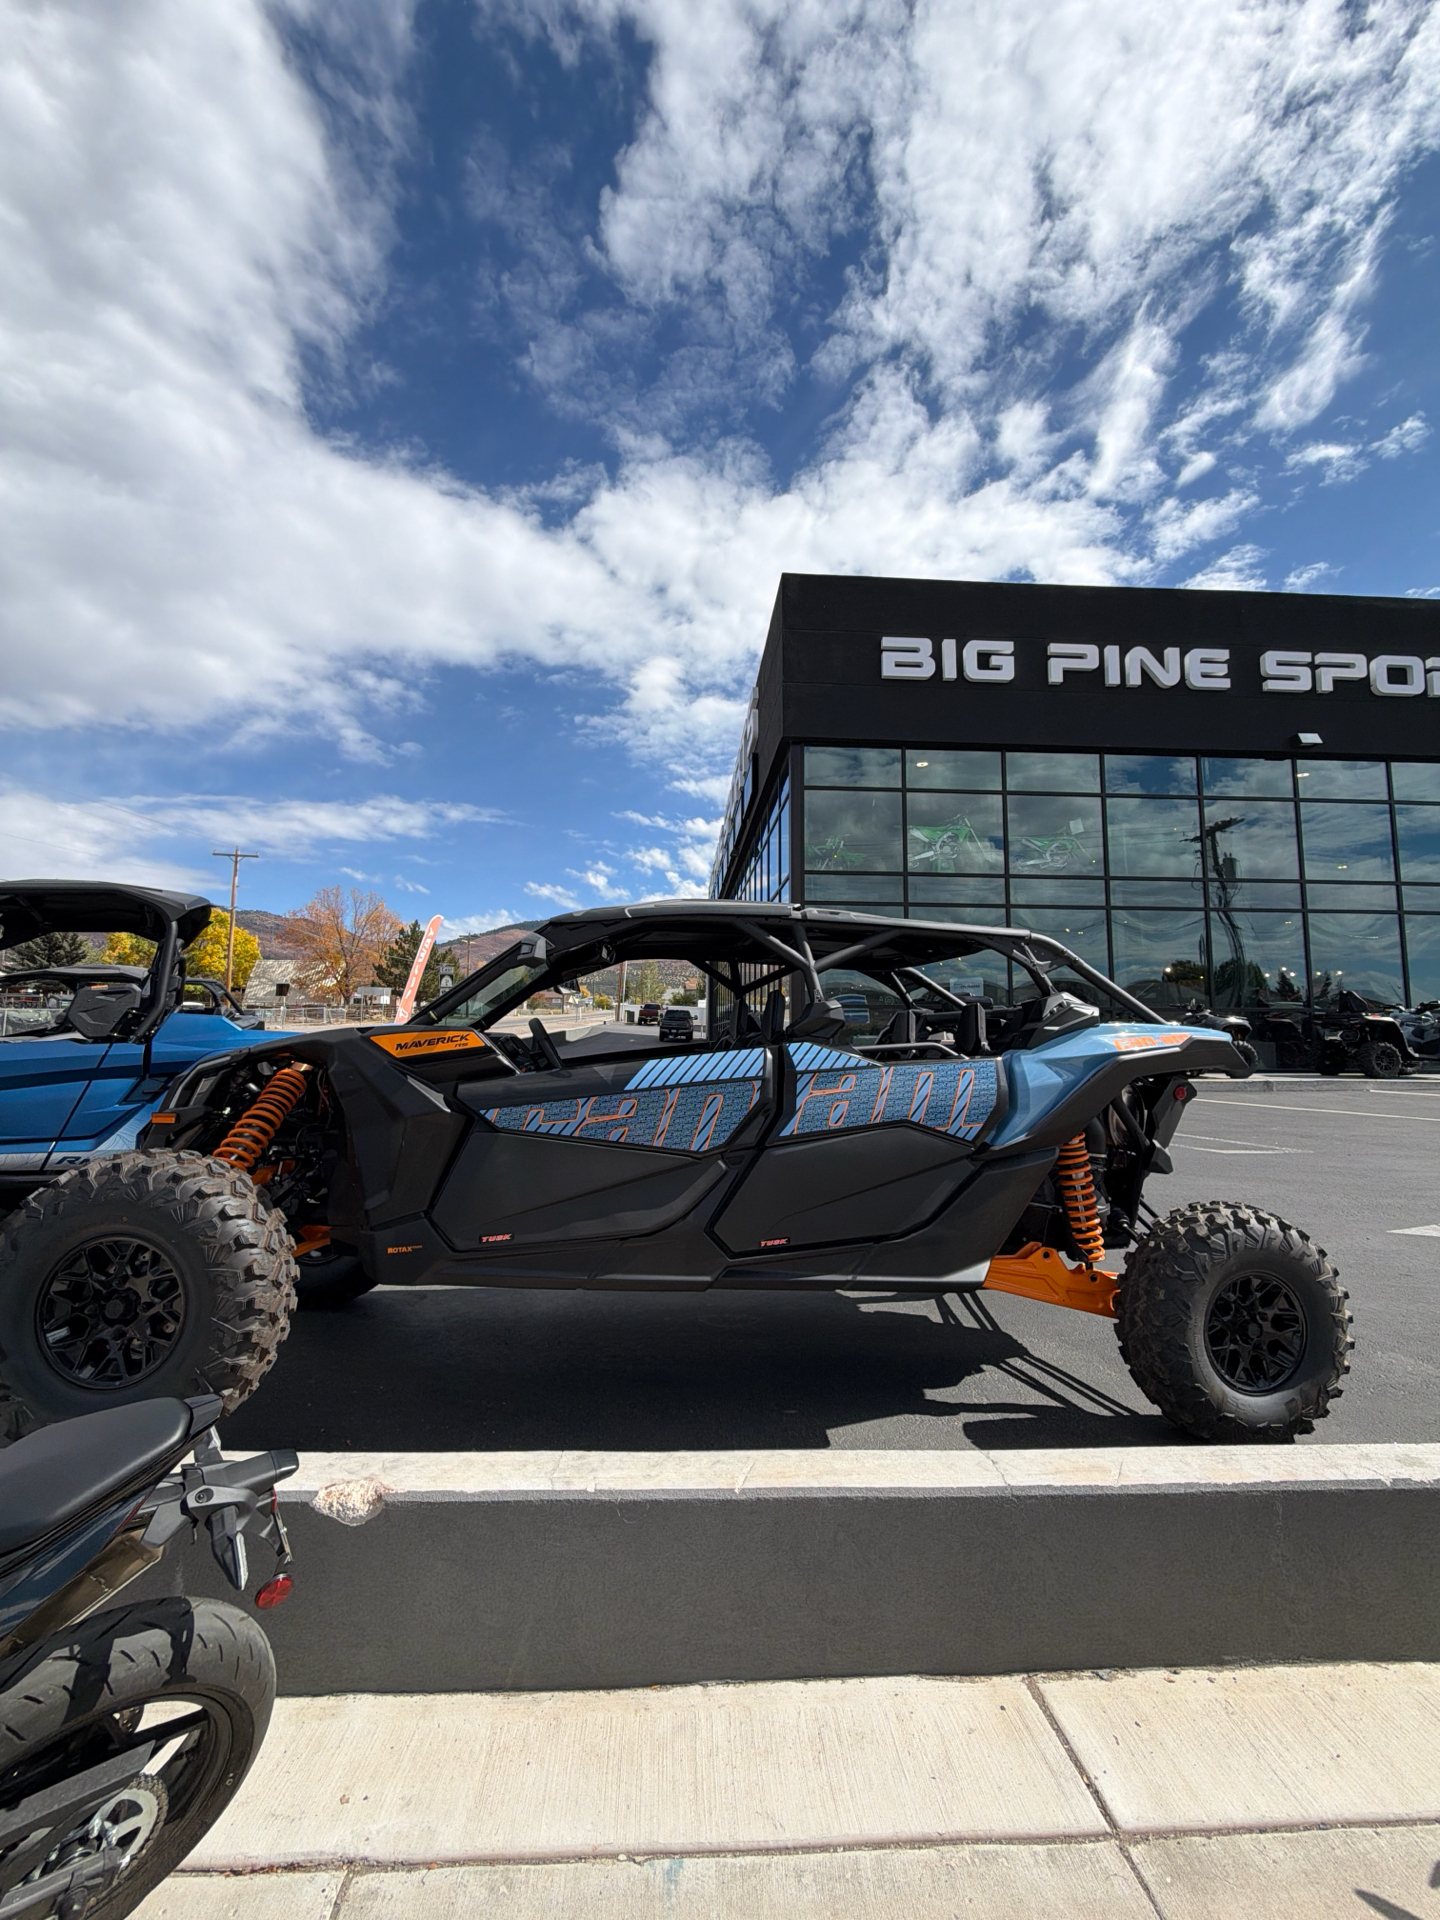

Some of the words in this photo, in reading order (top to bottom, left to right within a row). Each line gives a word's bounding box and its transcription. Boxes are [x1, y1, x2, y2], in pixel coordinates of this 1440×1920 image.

[881, 636, 1015, 684] BIG
[1047, 642, 1231, 691] PINE
[1260, 650, 1440, 698] SPO
[395, 1033, 470, 1050] MAVERICK
[481, 1233, 512, 1243] TUSK
[760, 1238, 788, 1247] TUSK
[387, 1246, 412, 1254] ROTAX
